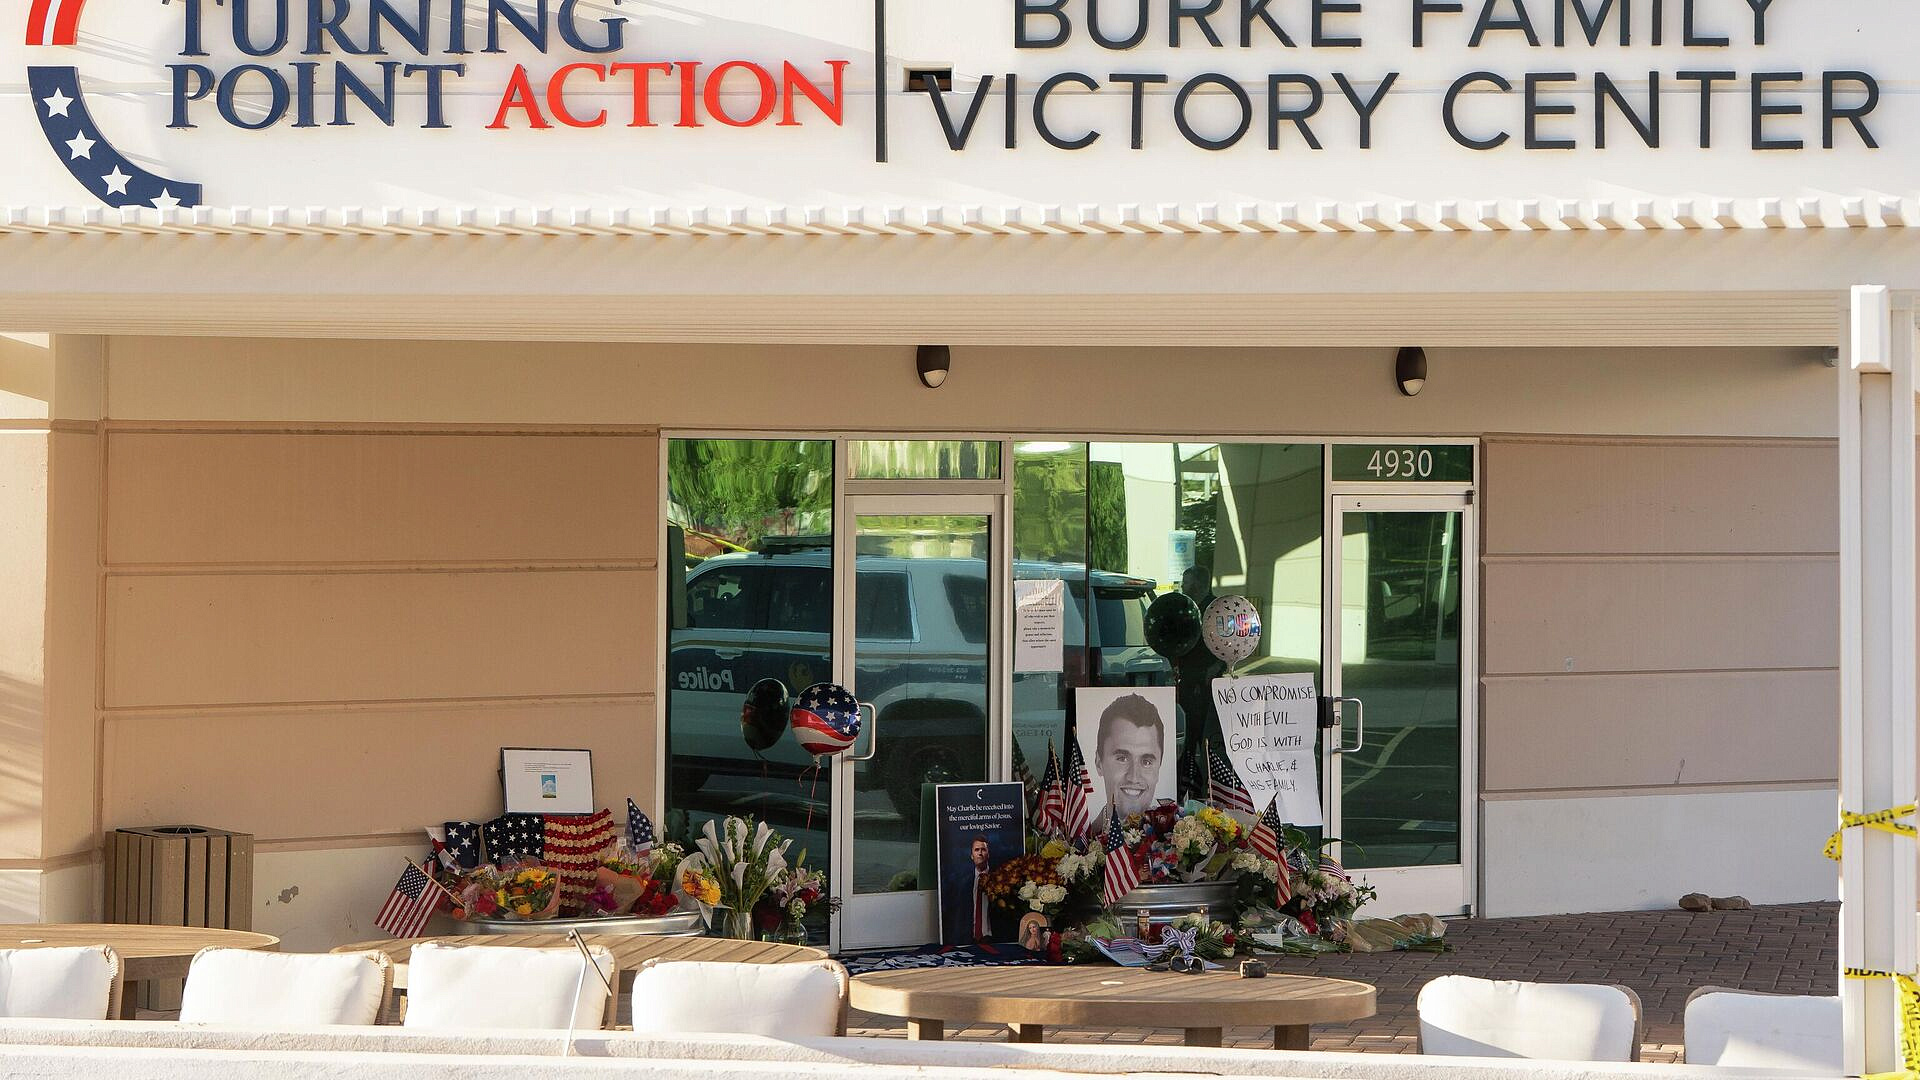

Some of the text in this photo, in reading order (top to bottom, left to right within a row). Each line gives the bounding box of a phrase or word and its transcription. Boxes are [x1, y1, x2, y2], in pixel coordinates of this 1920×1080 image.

[164, 0, 629, 57] TURNING
[1015, 0, 1774, 51] BURKE FAMILY
[165, 61, 849, 130] POINT ACTION
[921, 71, 1880, 151] VICTORY CENTER
[1367, 450, 1433, 477] 4930
[1216, 613, 1261, 637] USA
[1218, 685, 1315, 705] NO COMPROMISE
[1236, 710, 1297, 728] WITH EVIL
[1274, 736, 1302, 747] WITH
[1248, 780, 1265, 791] HIS
[946, 805, 957, 813] May
[969, 823, 984, 831] loving
